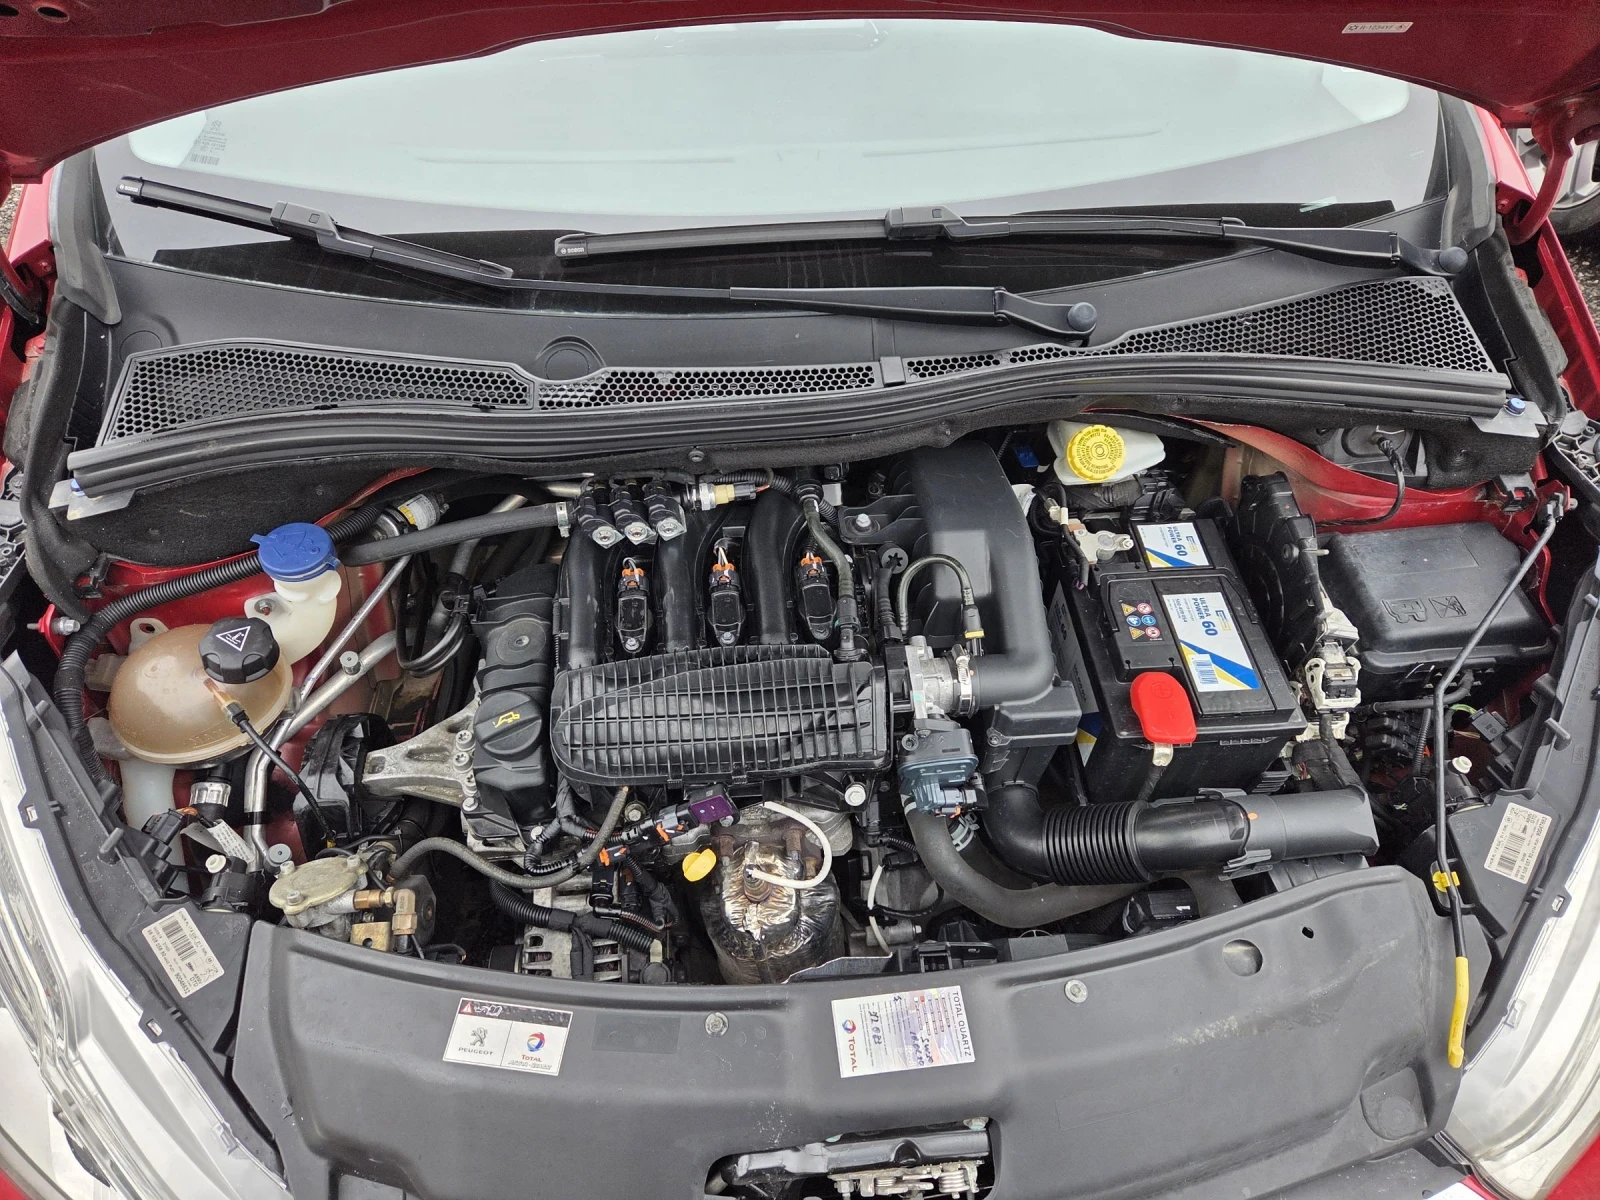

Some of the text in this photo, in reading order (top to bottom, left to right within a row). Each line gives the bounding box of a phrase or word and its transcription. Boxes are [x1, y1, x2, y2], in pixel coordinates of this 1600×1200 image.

[1167, 526, 1177, 543] POWER
[1173, 526, 1182, 541] ULTRA
[1174, 544, 1188, 556] 60
[1192, 598, 1205, 620] POWER
[1199, 598, 1211, 617] ULTRA
[1202, 620, 1218, 636] 60
[952, 991, 963, 1018] TOTAL
[958, 1021, 971, 1057] QUARTZ
[458, 1047, 494, 1056] PEUGEOT
[848, 1036, 858, 1072] TOTAL
